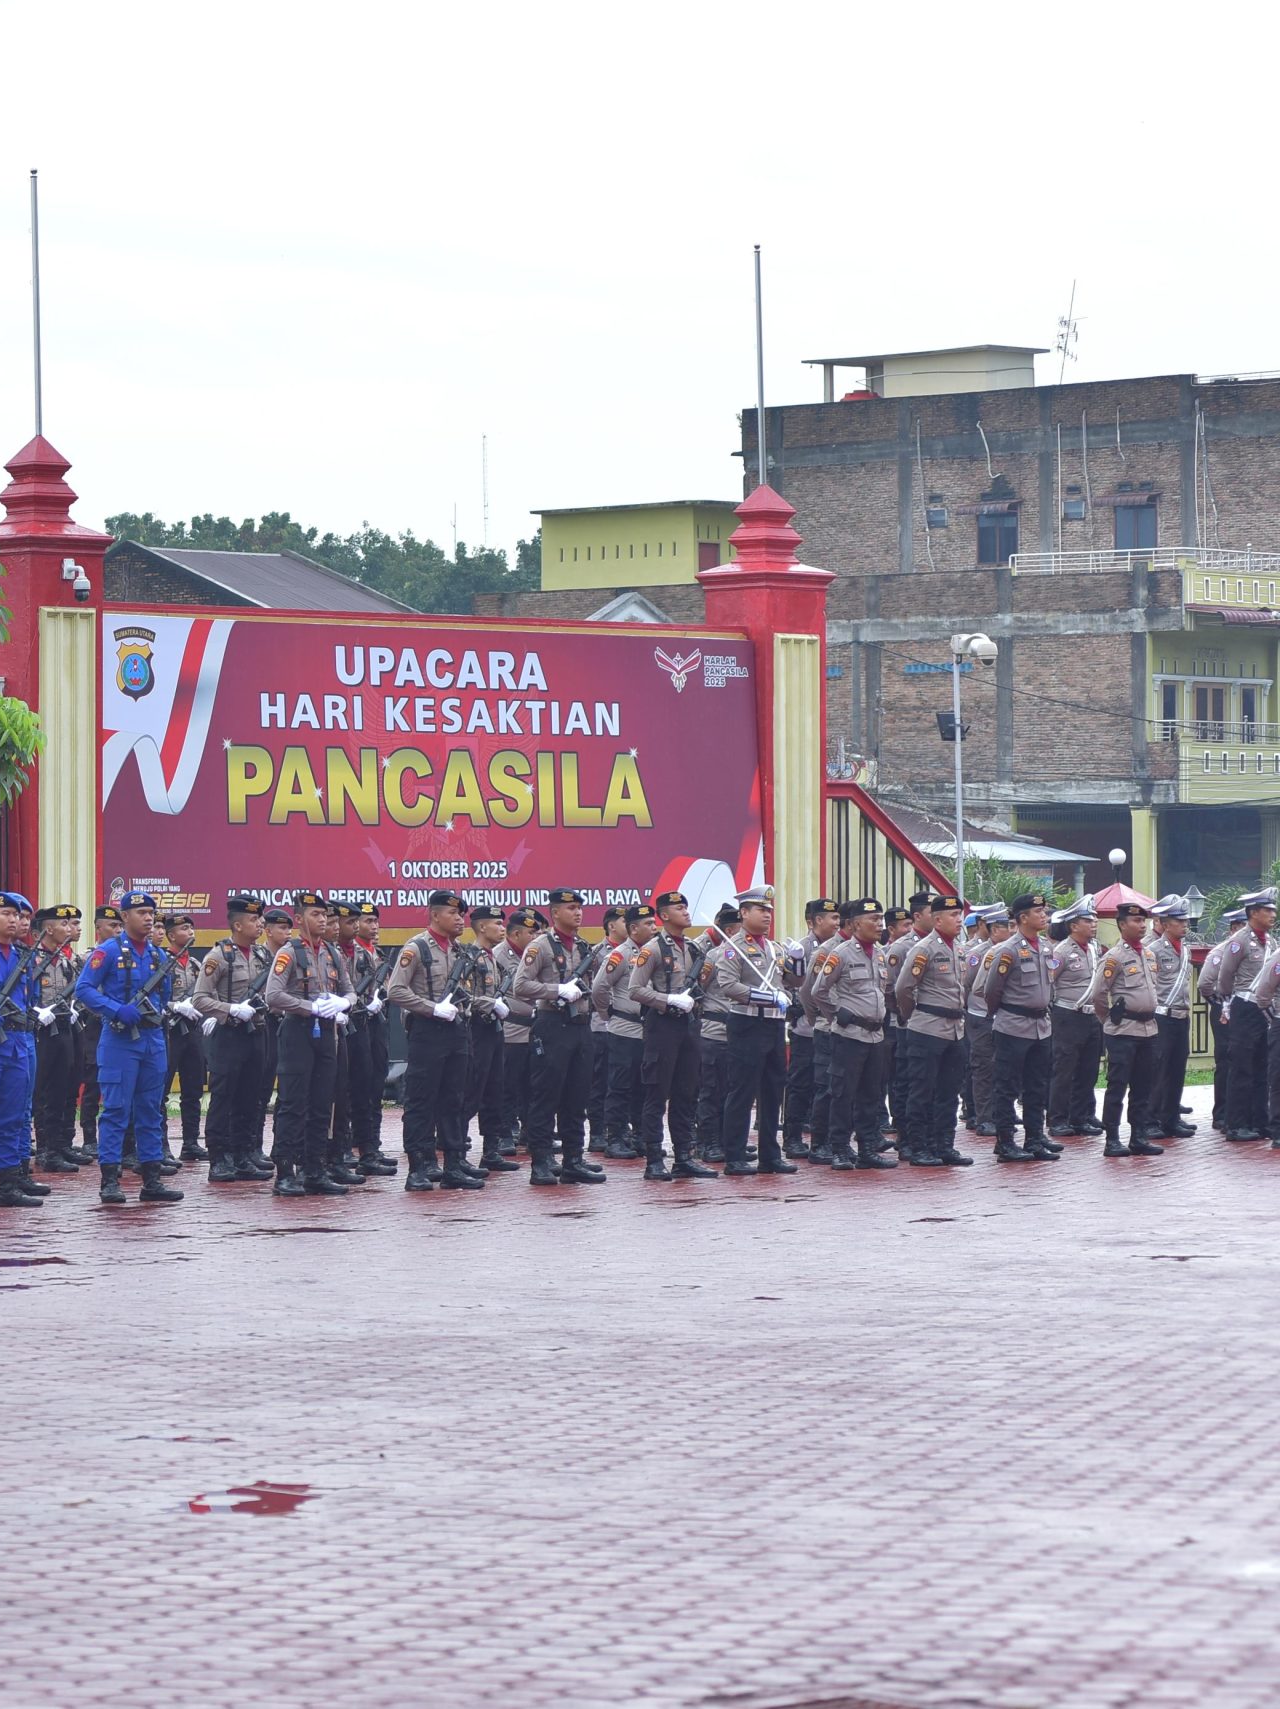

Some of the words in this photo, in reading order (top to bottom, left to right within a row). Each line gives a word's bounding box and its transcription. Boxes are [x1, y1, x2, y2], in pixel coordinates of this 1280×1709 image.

[115, 629, 138, 638] SUMATERA
[139, 630, 154, 639] UTARA
[333, 644, 549, 692] UPACARA
[704, 656, 736, 666] HARLAH
[704, 667, 748, 677] PANCASILA
[705, 677, 726, 687] 2025
[259, 692, 364, 731] HARI
[384, 696, 621, 737] KESAKTIAN
[225, 744, 654, 829] PANCASILA
[387, 861, 397, 878] 1
[400, 861, 469, 879] OKTOBER
[473, 861, 508, 879] 2025
[132, 877, 170, 886] TRANSFORMASI
[151, 893, 211, 908] RESISI
[461, 889, 521, 906] MENUJU
[524, 889, 603, 907] INDSIA
[606, 889, 642, 906] RAYA
